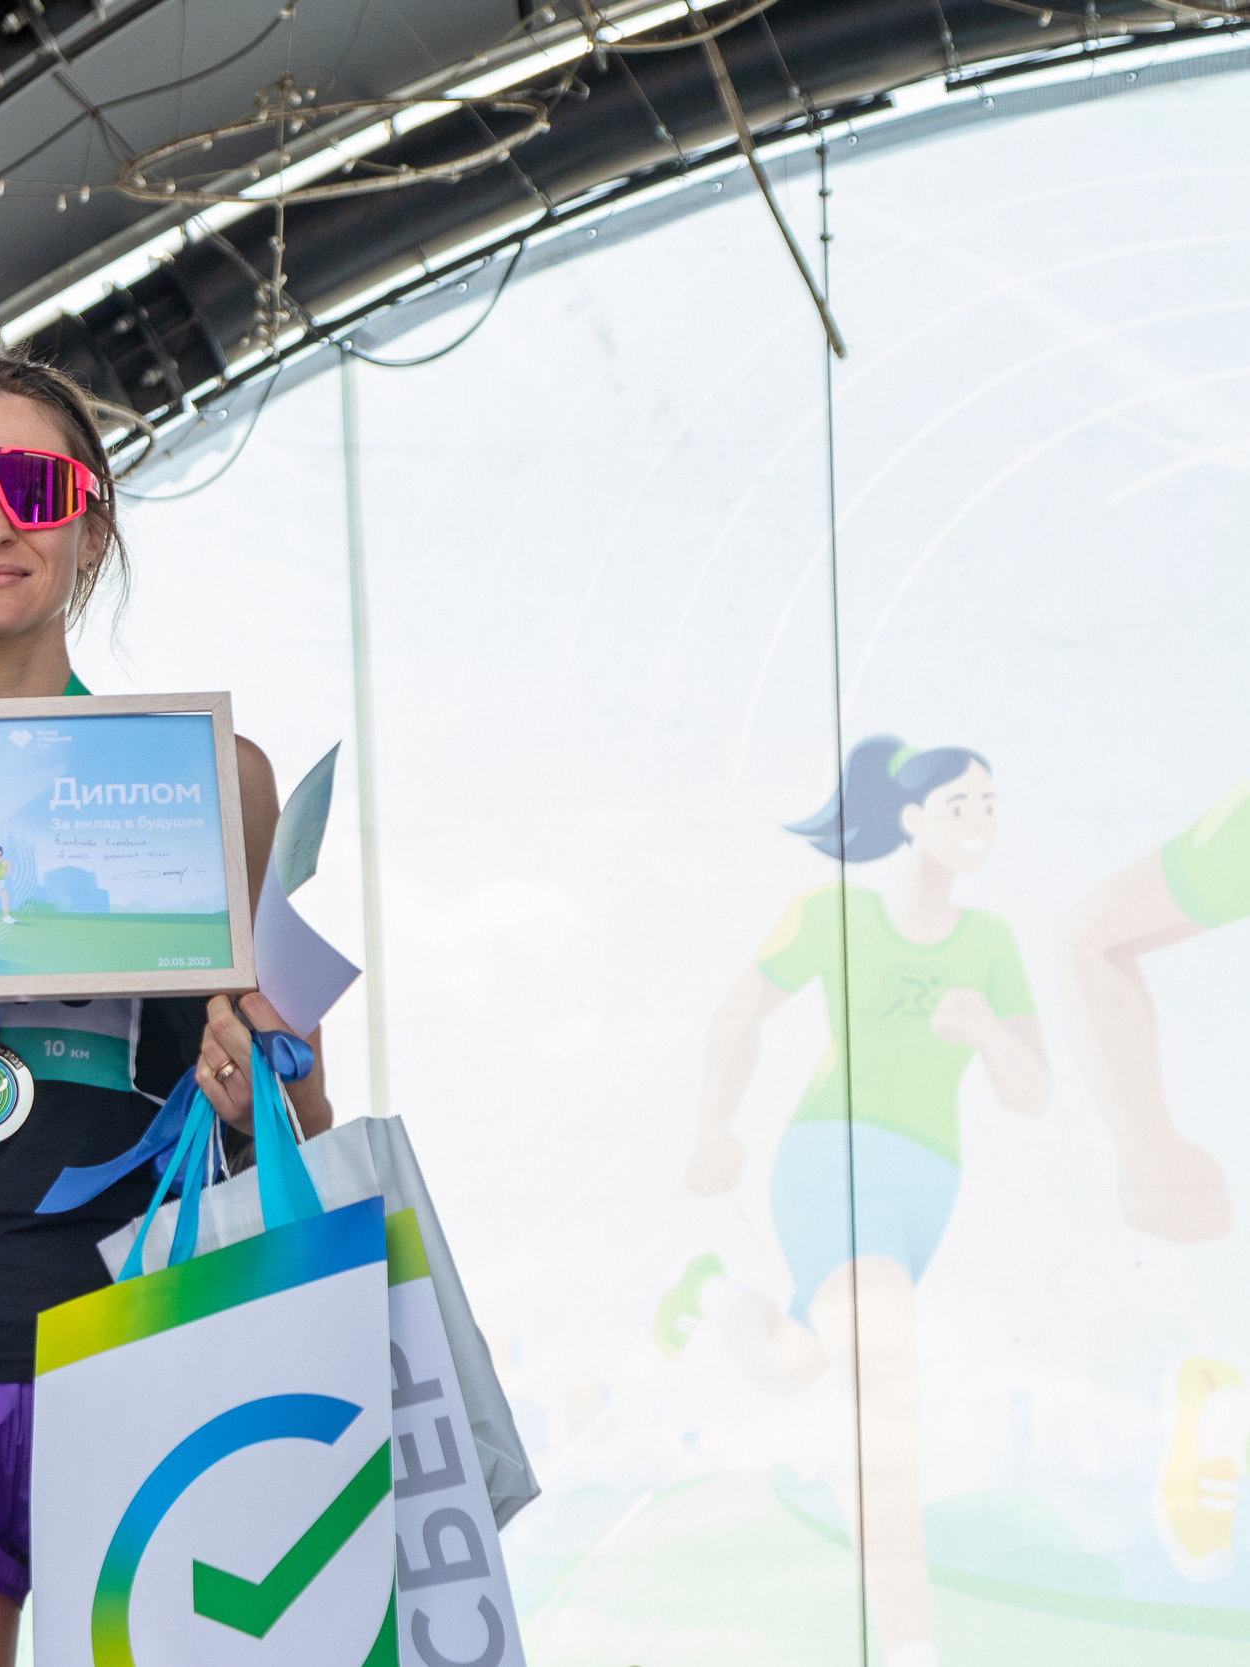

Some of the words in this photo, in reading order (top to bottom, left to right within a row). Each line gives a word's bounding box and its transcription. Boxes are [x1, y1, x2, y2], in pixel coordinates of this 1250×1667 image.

[49, 777, 201, 810] Диплом
[51, 817, 71, 830] За
[75, 819, 122, 831] вклад
[125, 819, 135, 829] в
[137, 815, 205, 831] будущее
[157, 956, 212, 967] 20.05.2023
[44, 1039, 66, 1057] 10
[70, 1048, 90, 1060] км
